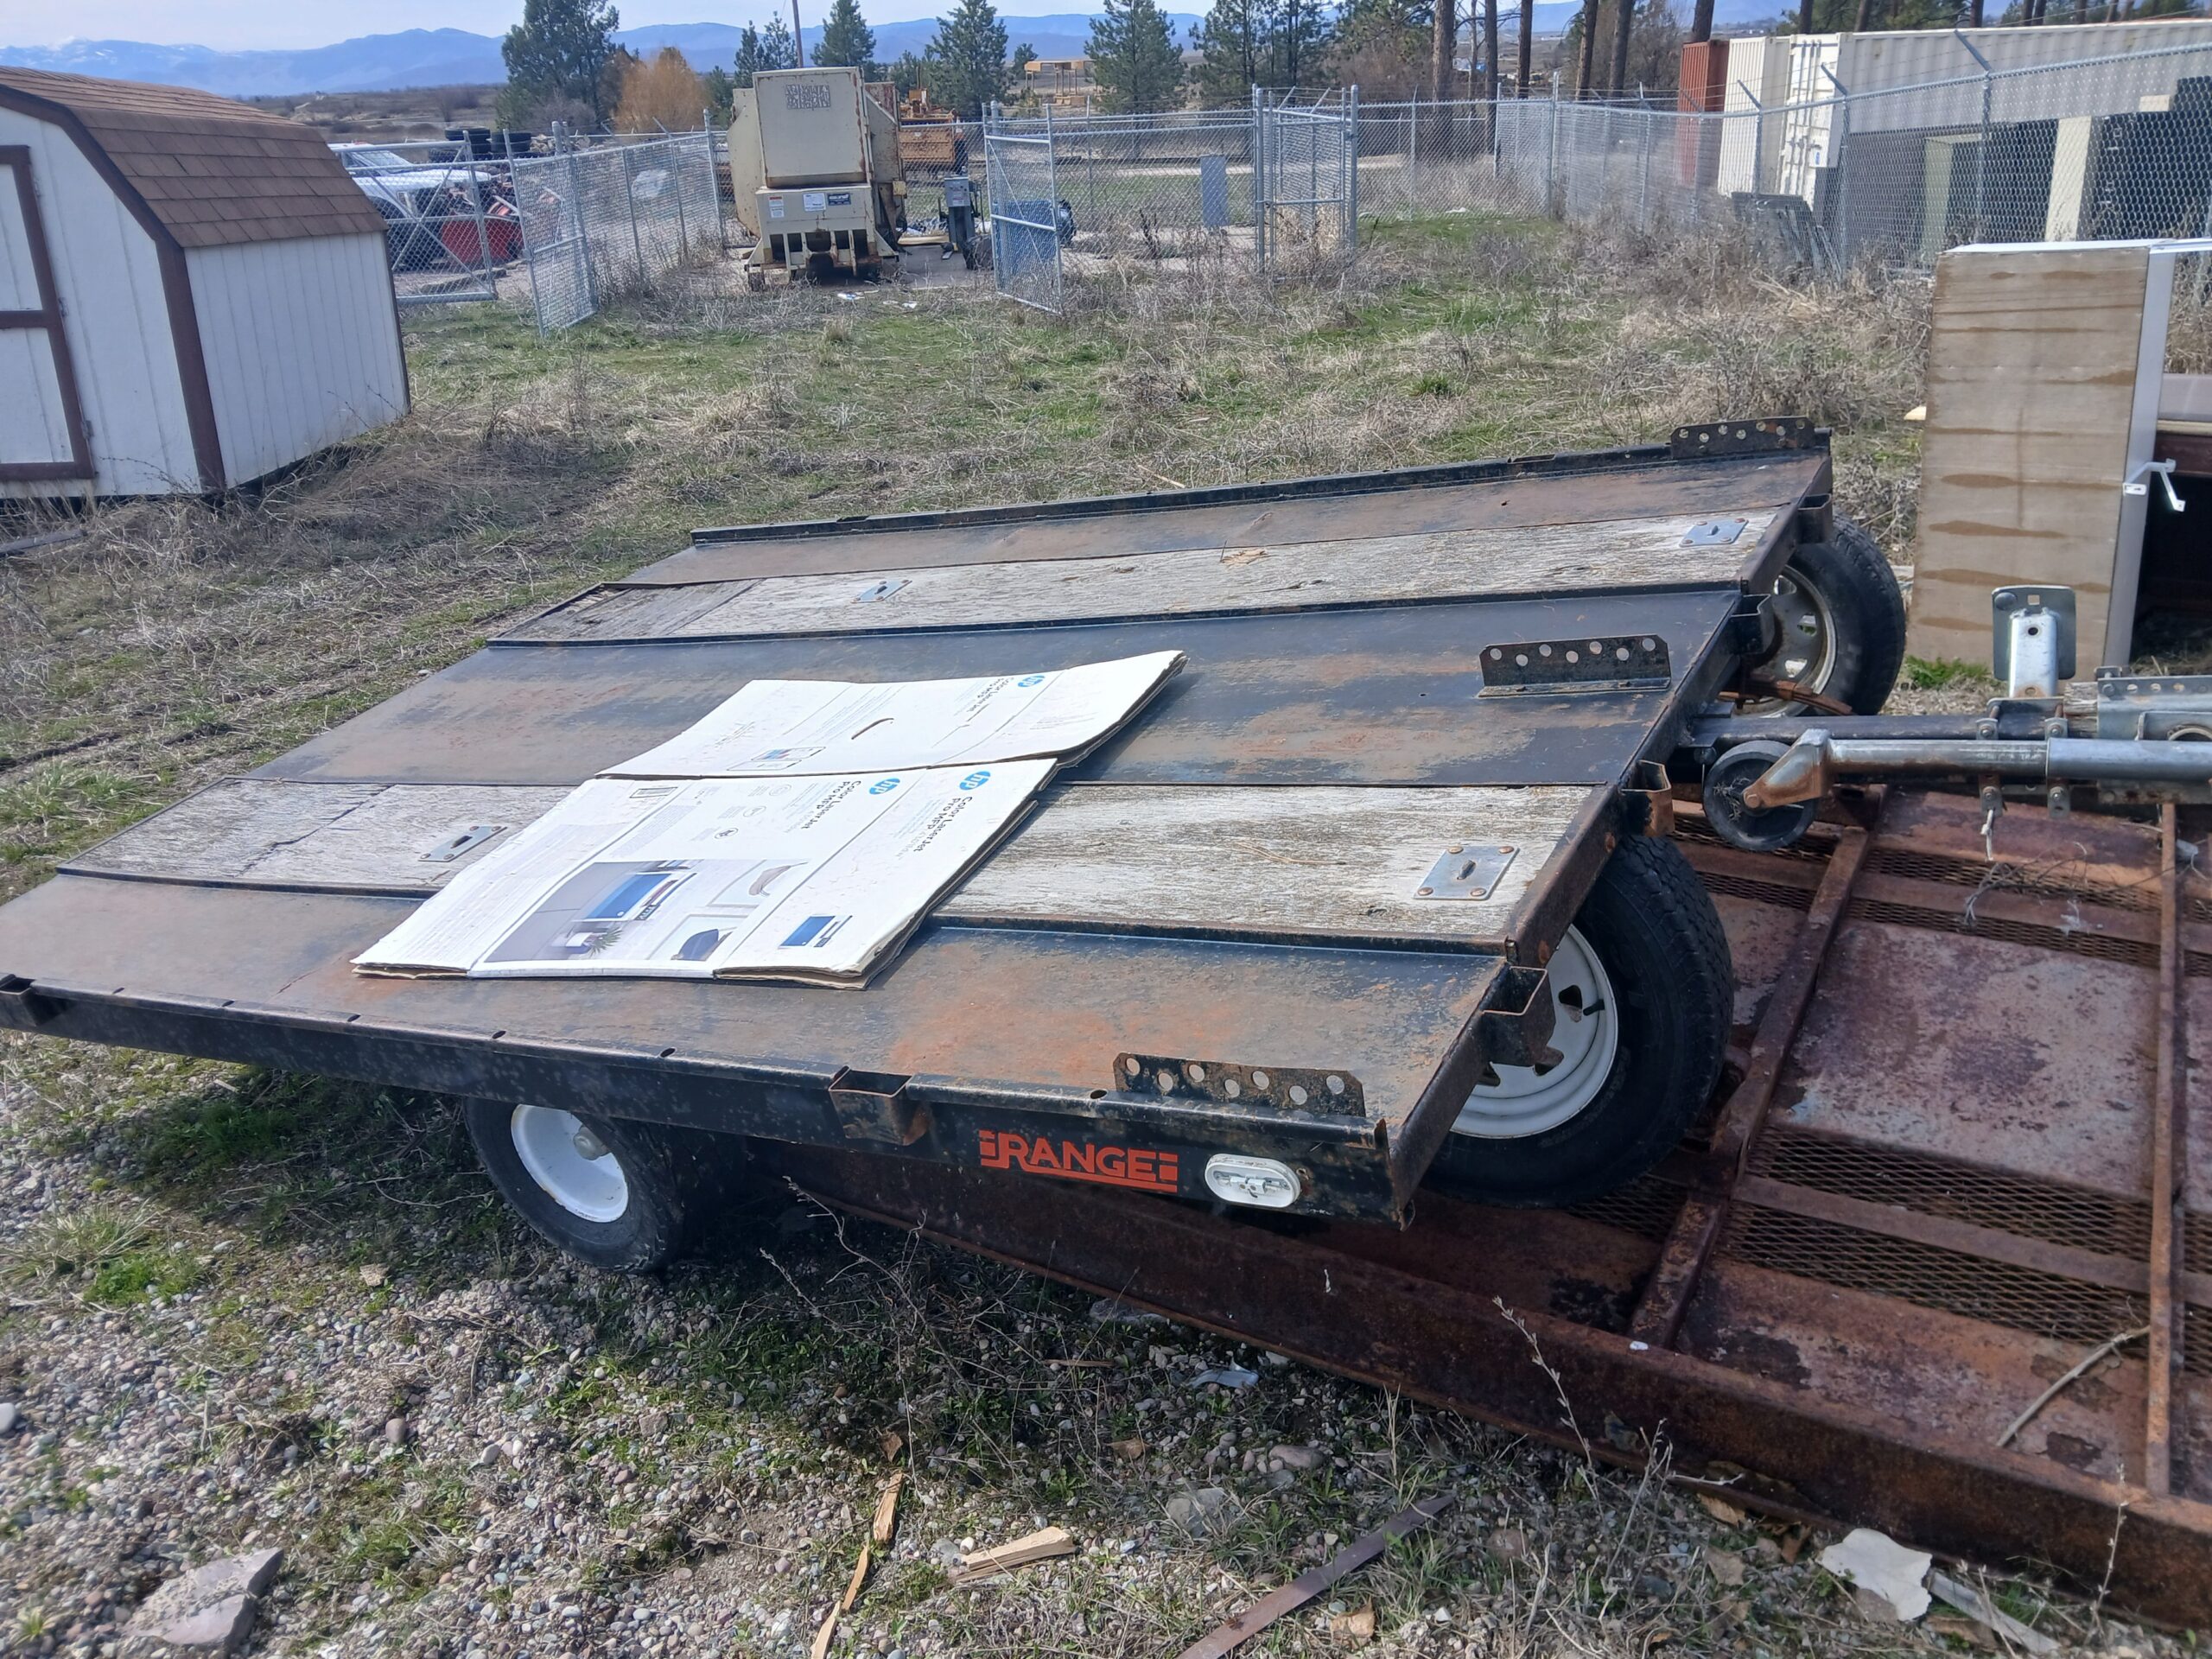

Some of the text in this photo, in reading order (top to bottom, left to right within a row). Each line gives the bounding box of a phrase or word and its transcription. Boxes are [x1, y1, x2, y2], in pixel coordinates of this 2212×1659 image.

[838, 781, 861, 799] Color
[869, 779, 899, 795] hp
[960, 772, 989, 791] hp
[816, 781, 850, 810] Pro MFP
[944, 798, 961, 810] Pro
[800, 801, 840, 830] LaserJet
[949, 797, 973, 817] Color
[927, 813, 947, 830] MFP
[913, 819, 952, 852] LaserJet
